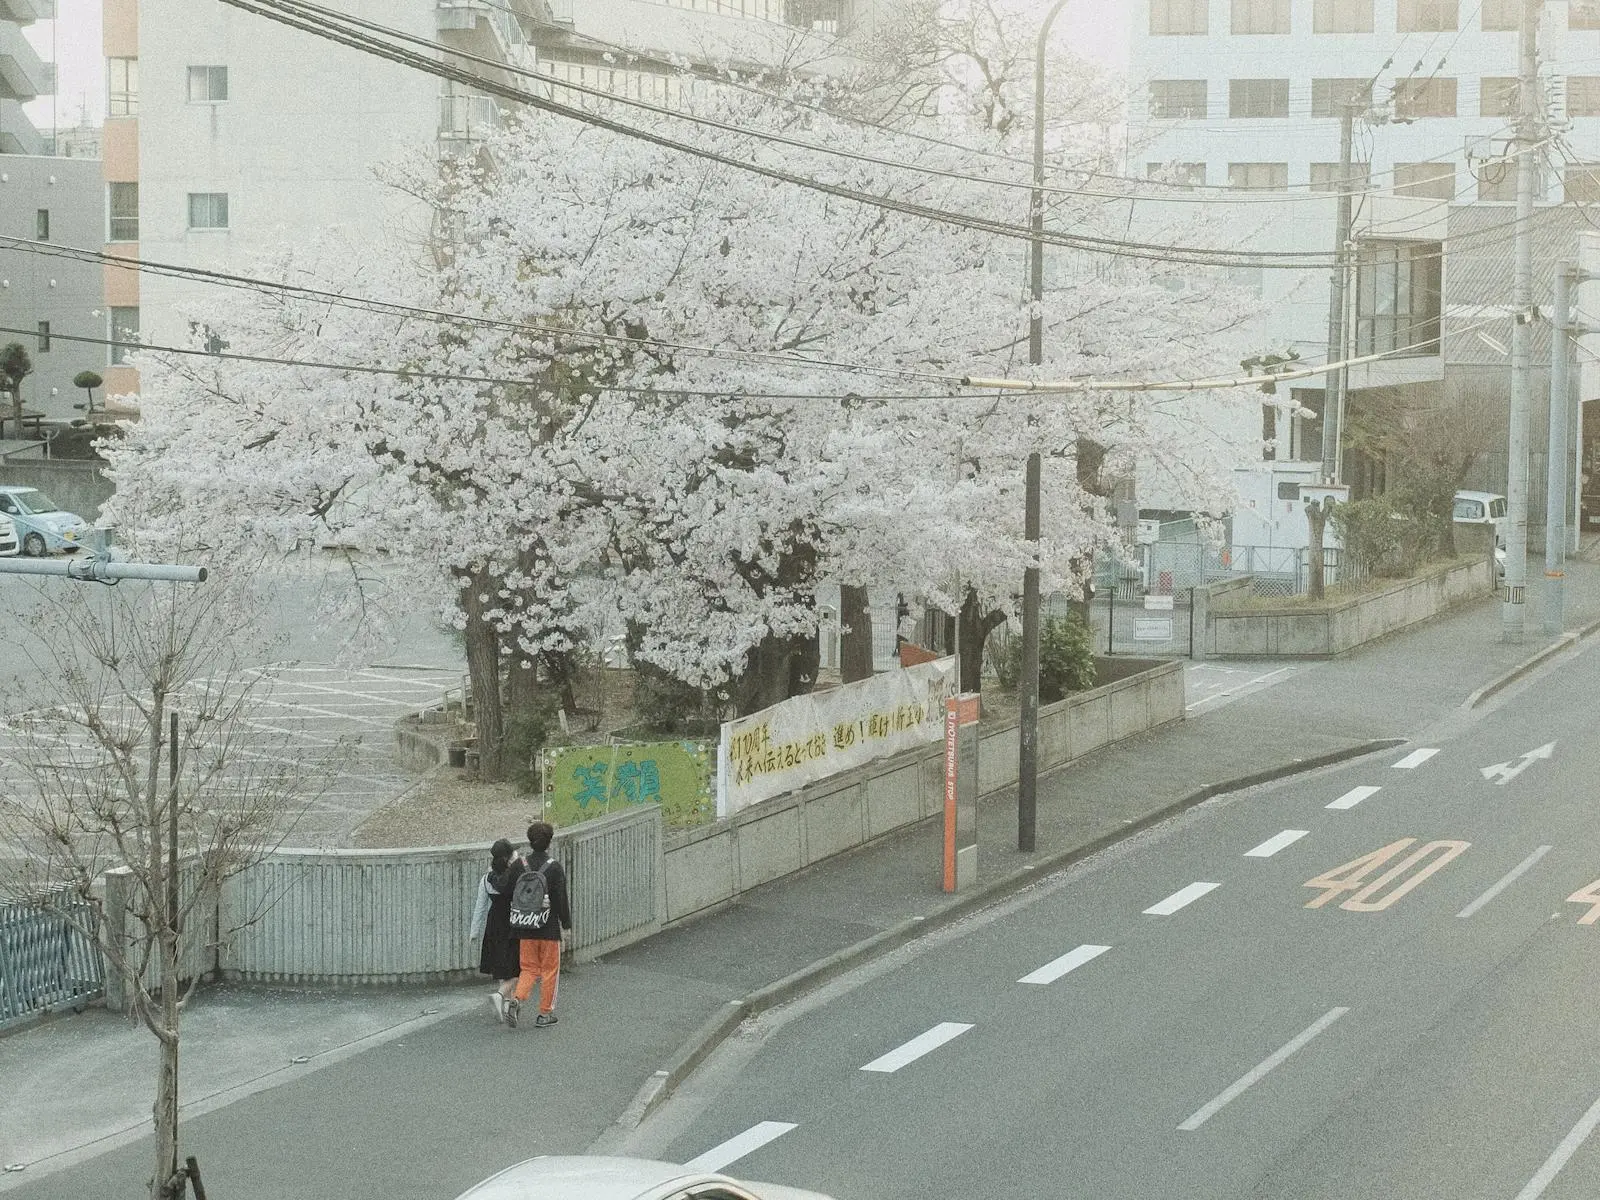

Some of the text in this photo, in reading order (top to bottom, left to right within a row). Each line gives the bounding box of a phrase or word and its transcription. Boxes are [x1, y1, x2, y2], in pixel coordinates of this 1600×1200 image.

[572, 759, 663, 809] 笑顔
[947, 781, 956, 800] STOP
[1302, 837, 1472, 912] 40
